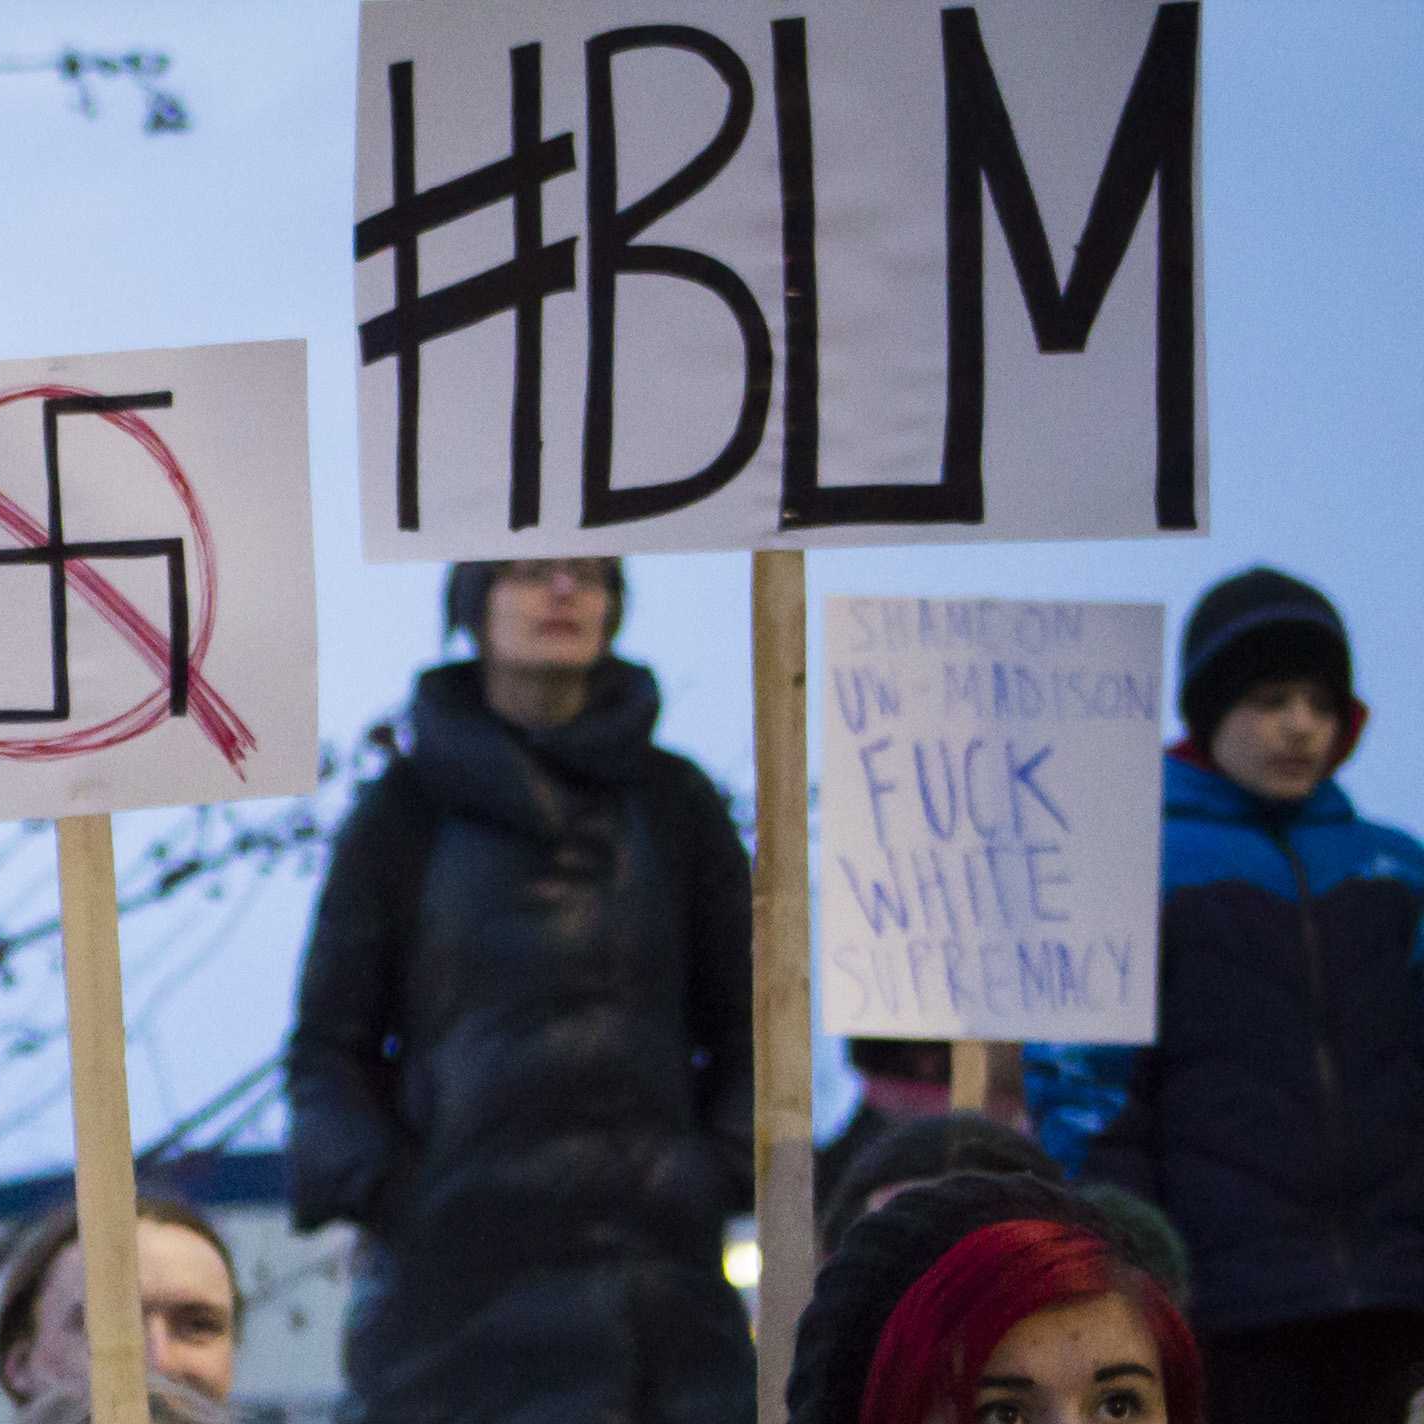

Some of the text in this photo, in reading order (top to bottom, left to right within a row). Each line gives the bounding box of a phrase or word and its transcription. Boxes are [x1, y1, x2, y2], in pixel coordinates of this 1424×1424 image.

[355, 1, 1200, 531] #BLM
[860, 736, 1071, 848] FUCK
[838, 843, 1073, 939] WHITE
